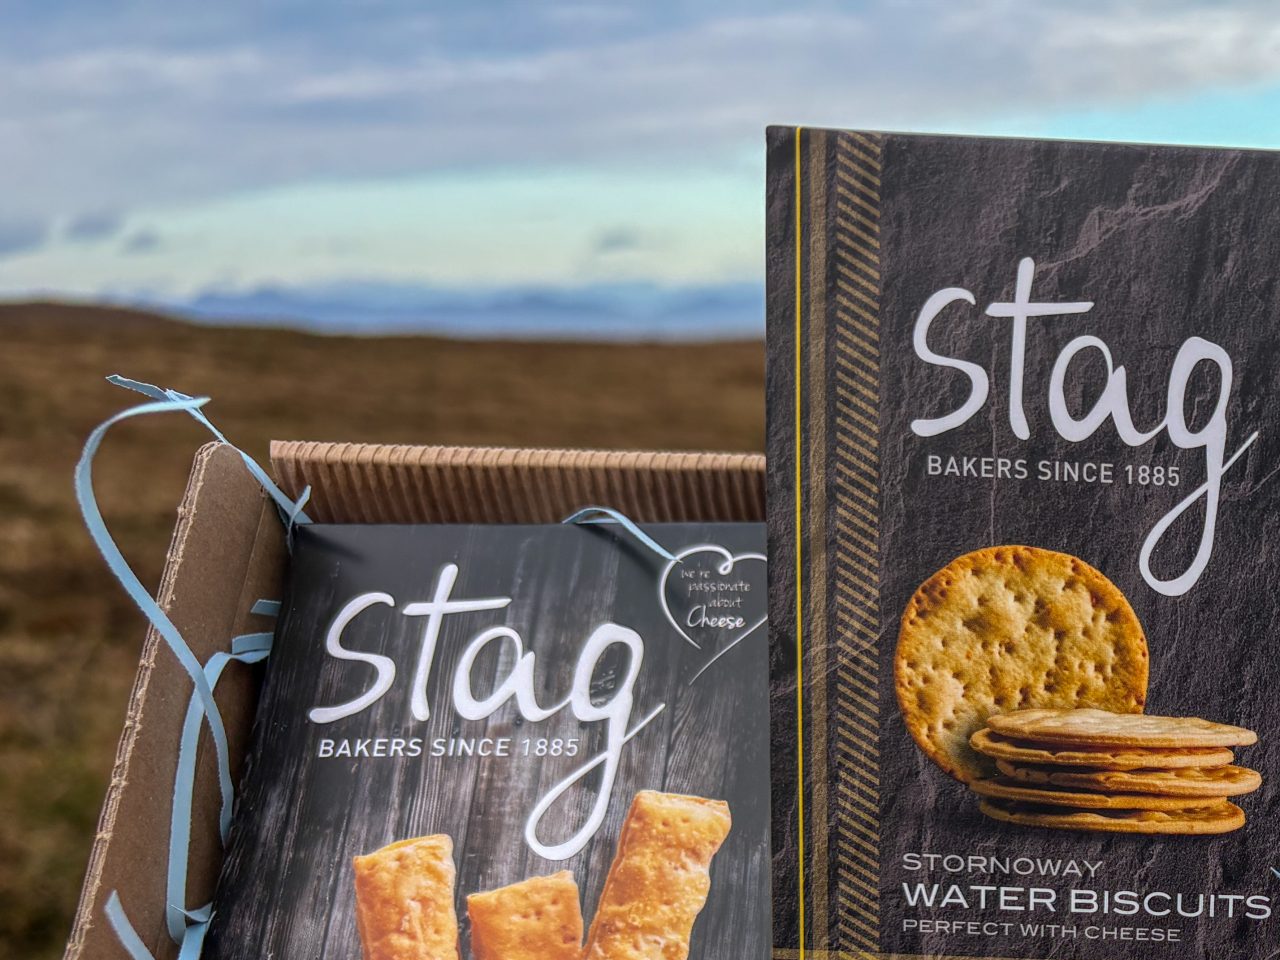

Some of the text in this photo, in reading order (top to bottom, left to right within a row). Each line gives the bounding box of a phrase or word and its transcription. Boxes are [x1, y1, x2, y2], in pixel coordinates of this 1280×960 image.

[909, 256, 1260, 598] stag
[926, 455, 1181, 488] BAKERS SINCE 1885
[687, 580, 752, 598] passionate
[708, 595, 742, 608] about
[687, 604, 746, 630] Cheese
[308, 562, 668, 862] stag
[317, 737, 581, 760] BAKERS SINCE 1885
[902, 852, 1103, 879] STORNOWAY
[902, 883, 1273, 920] WATER BISCUITS
[902, 918, 1182, 943] PERFECT WITH CHEESE
